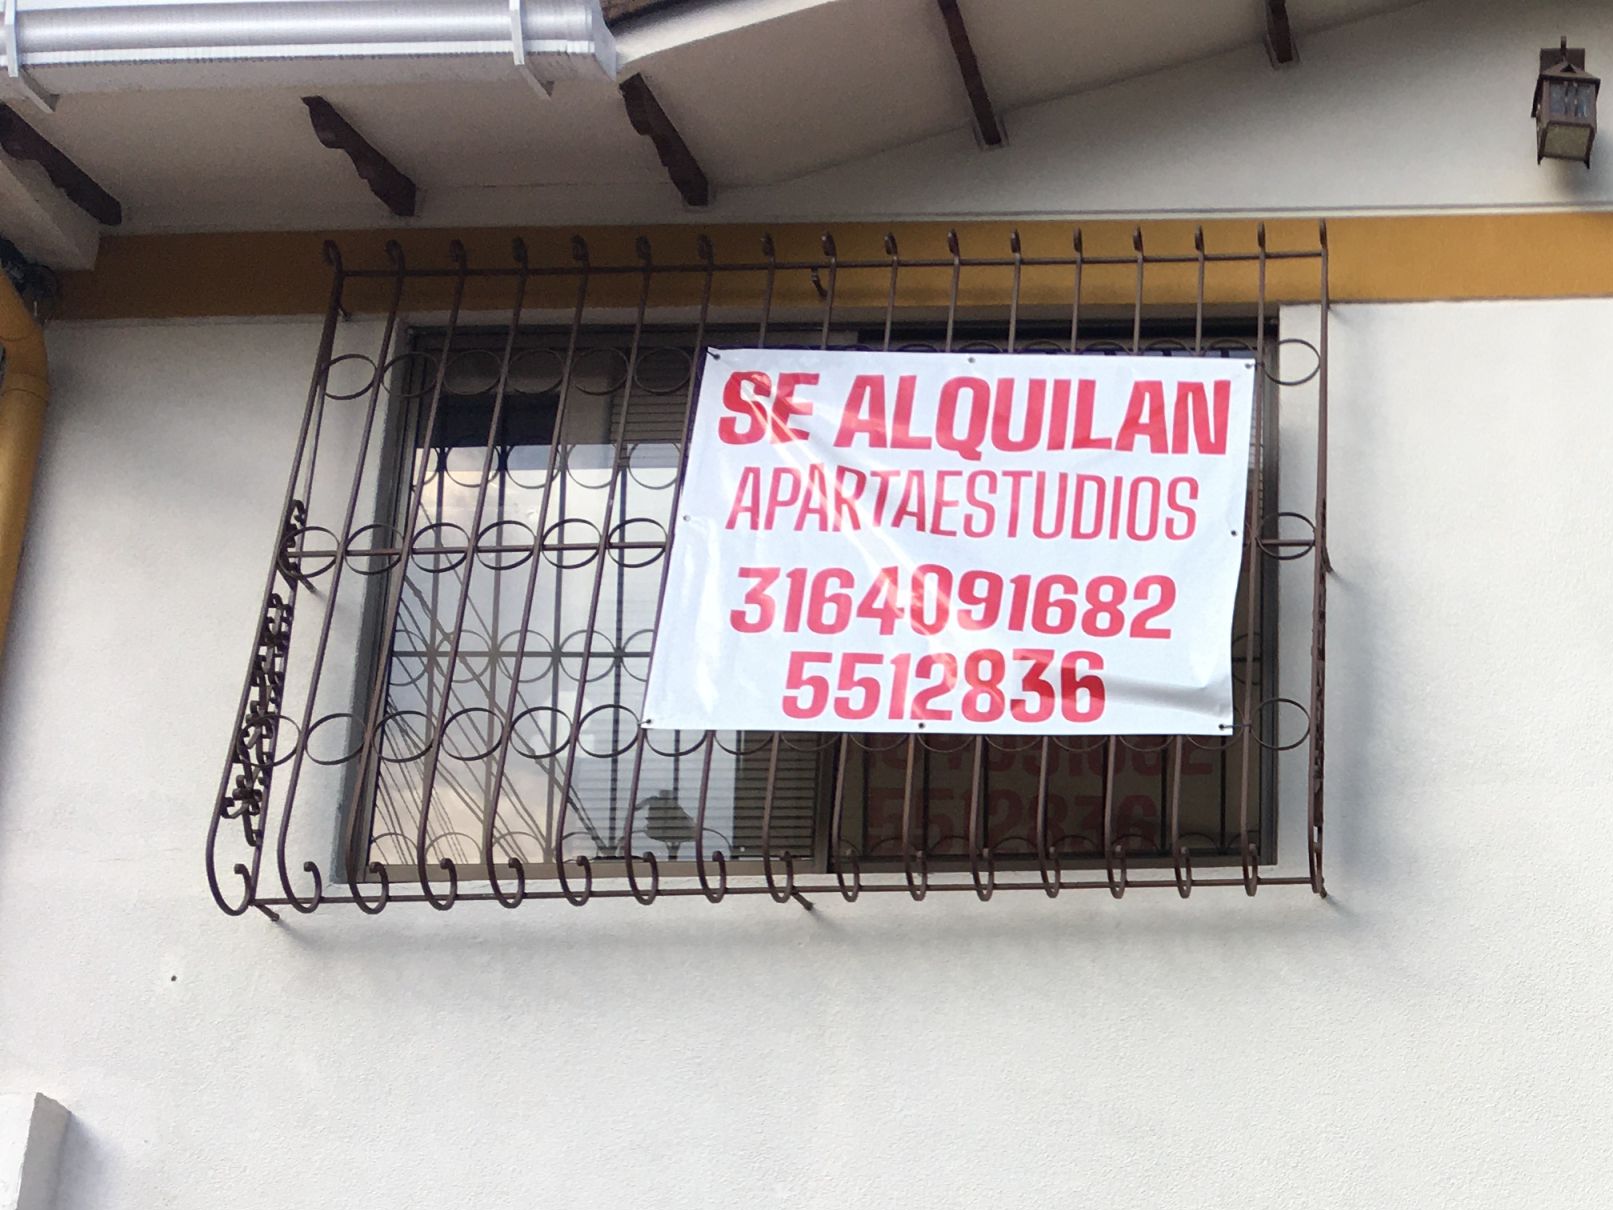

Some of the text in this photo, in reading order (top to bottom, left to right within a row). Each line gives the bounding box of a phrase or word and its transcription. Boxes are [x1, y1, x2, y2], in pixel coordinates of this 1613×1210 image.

[718, 371, 1232, 461] SE ALQUILAN
[725, 464, 1199, 541] APARTAESTUDIOS
[729, 564, 1176, 640] 3164091682
[781, 649, 1106, 723] 5512836
